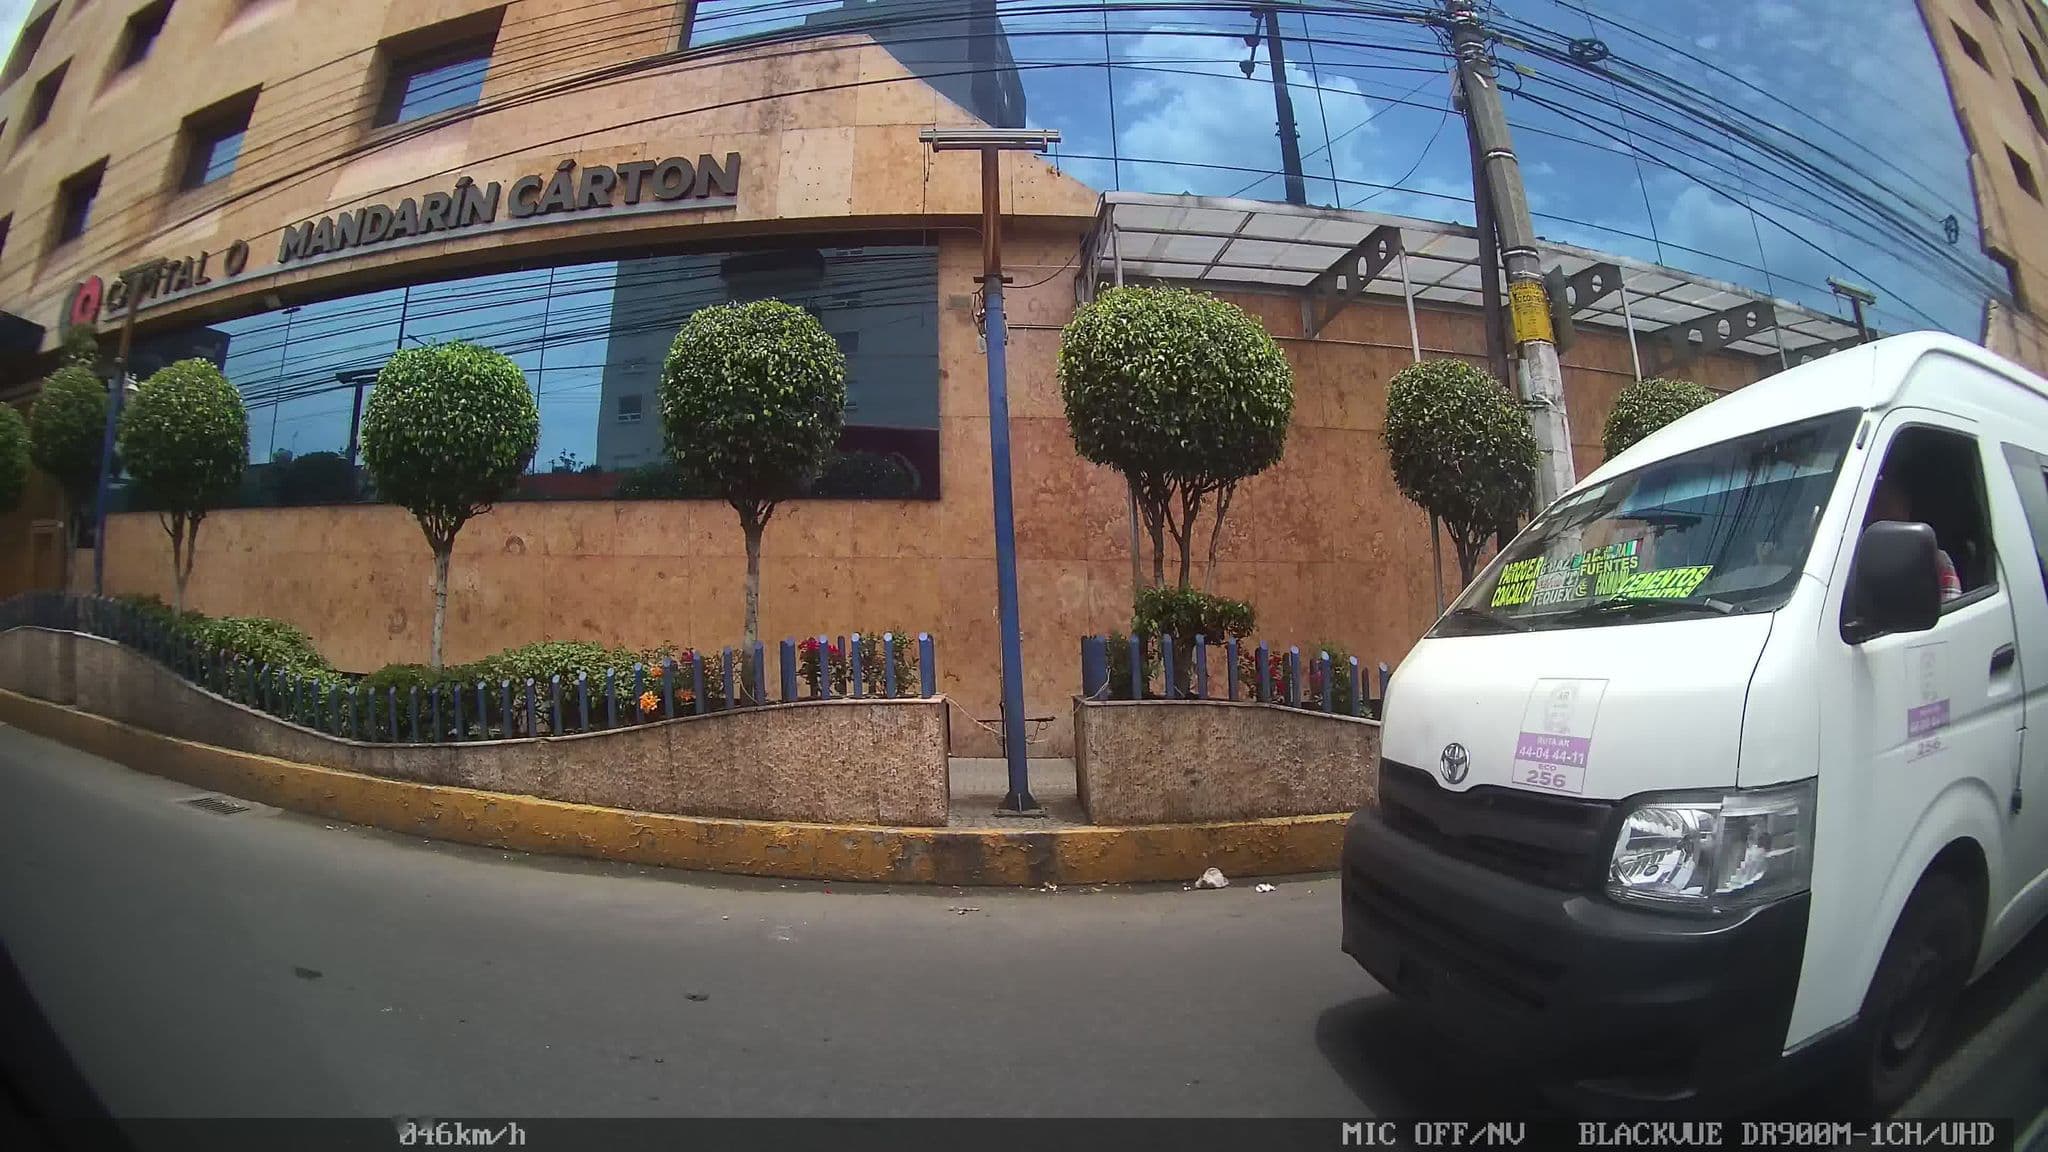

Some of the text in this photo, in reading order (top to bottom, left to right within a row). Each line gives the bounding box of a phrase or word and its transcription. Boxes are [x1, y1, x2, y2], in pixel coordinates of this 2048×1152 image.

[278, 152, 741, 264] MANDARÍN CÁRTON
[224, 239, 250, 278] O
[1580, 556, 1639, 577] FUENTES
[1621, 567, 1709, 593] CEMENTOS
[1526, 769, 1566, 788] 256
[1538, 763, 1557, 772] ECO
